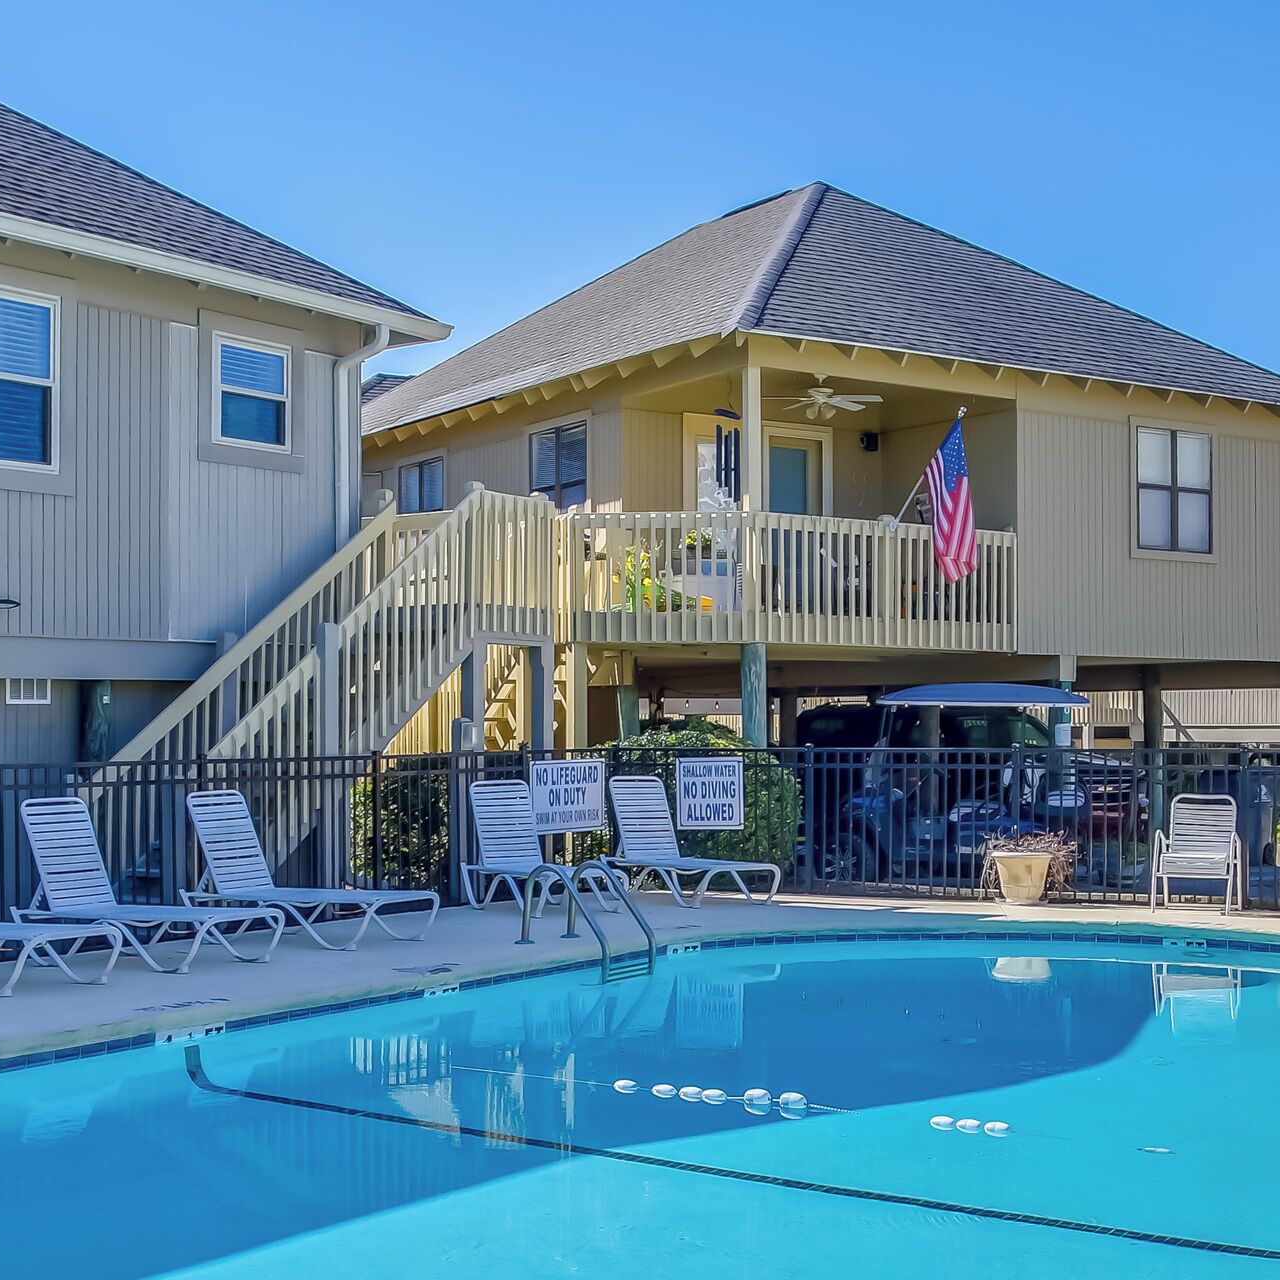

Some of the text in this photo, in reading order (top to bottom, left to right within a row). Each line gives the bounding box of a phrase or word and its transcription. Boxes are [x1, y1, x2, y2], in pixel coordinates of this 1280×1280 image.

[536, 766, 598, 786] NO LIFEGUARD
[682, 765, 736, 777] SHALLOW WATER
[549, 786, 586, 807] ON DUTY
[684, 780, 736, 799] NO DIVING
[536, 809, 600, 825] SWIM AT YOUR OWN RISK
[687, 803, 734, 821] ALLOWED
